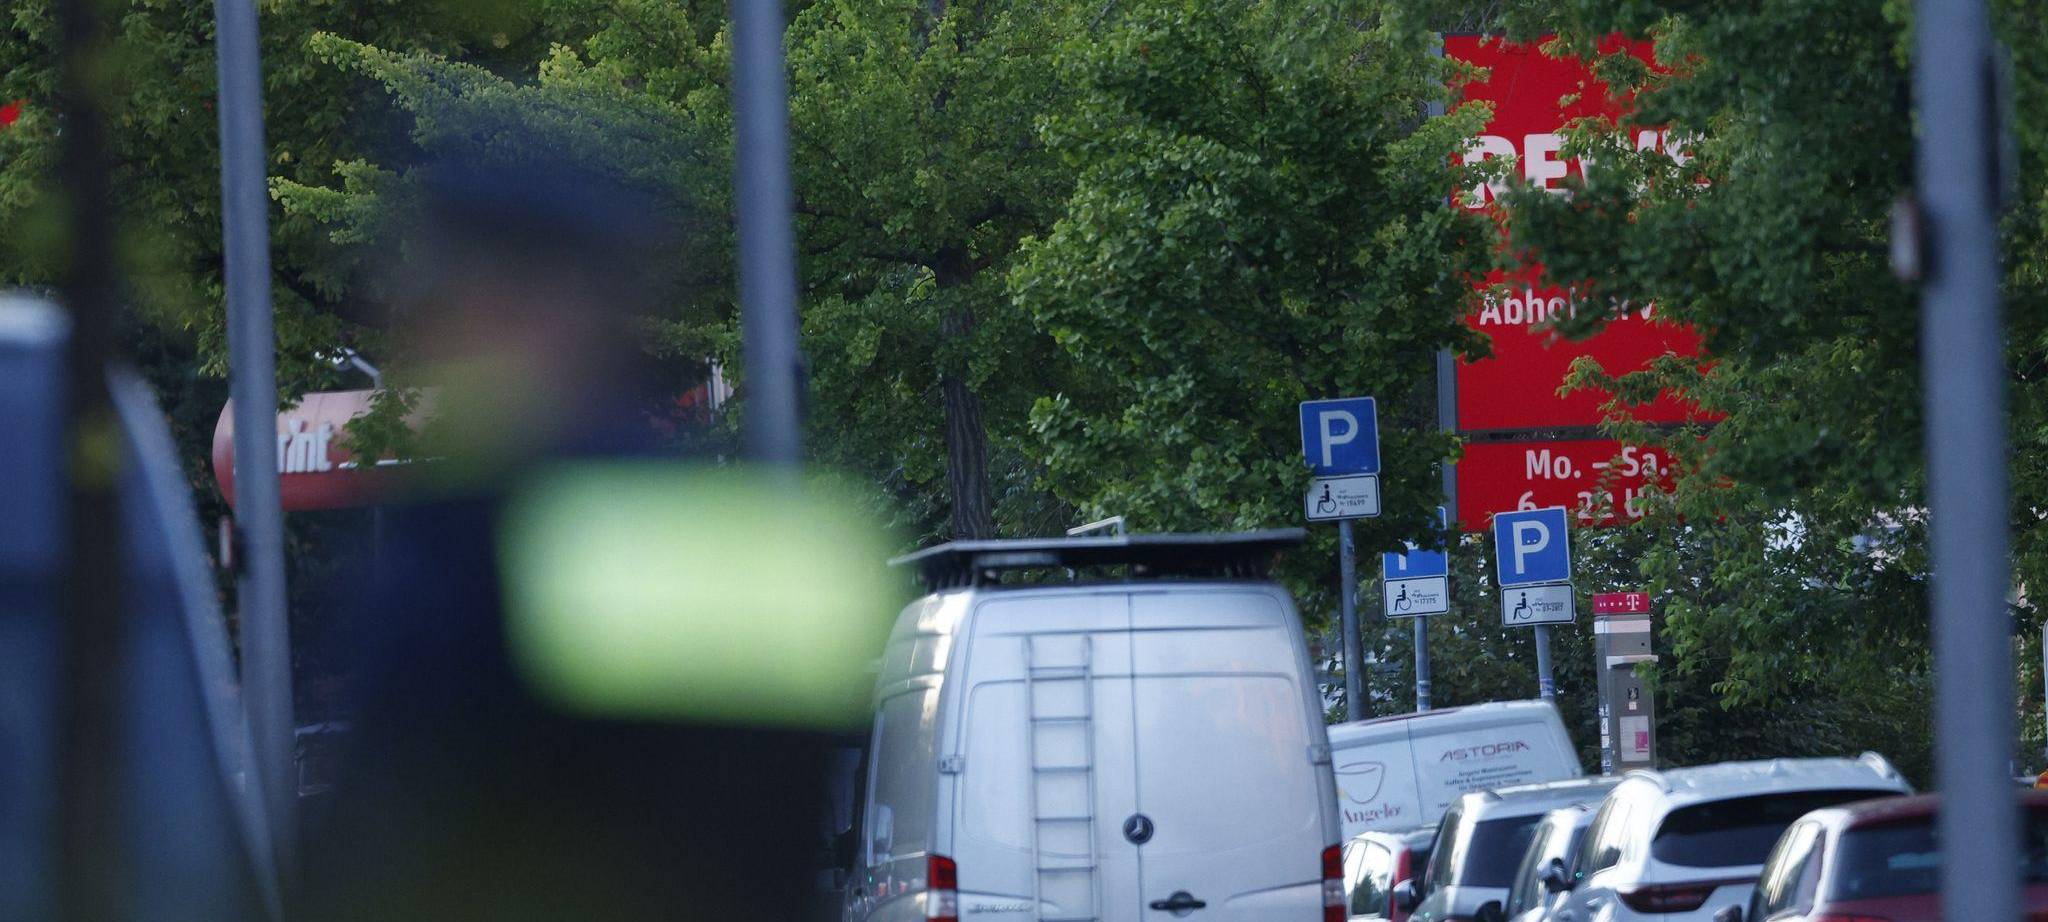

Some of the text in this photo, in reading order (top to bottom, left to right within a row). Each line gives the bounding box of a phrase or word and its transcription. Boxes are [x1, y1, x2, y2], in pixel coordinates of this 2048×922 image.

[1319, 410, 1358, 467] P
[1526, 449, 1581, 480] Mo.
[1621, 446, 1667, 477] Sa.
[1512, 520, 1549, 574] P
[1440, 740, 1530, 761] ASTORIA
